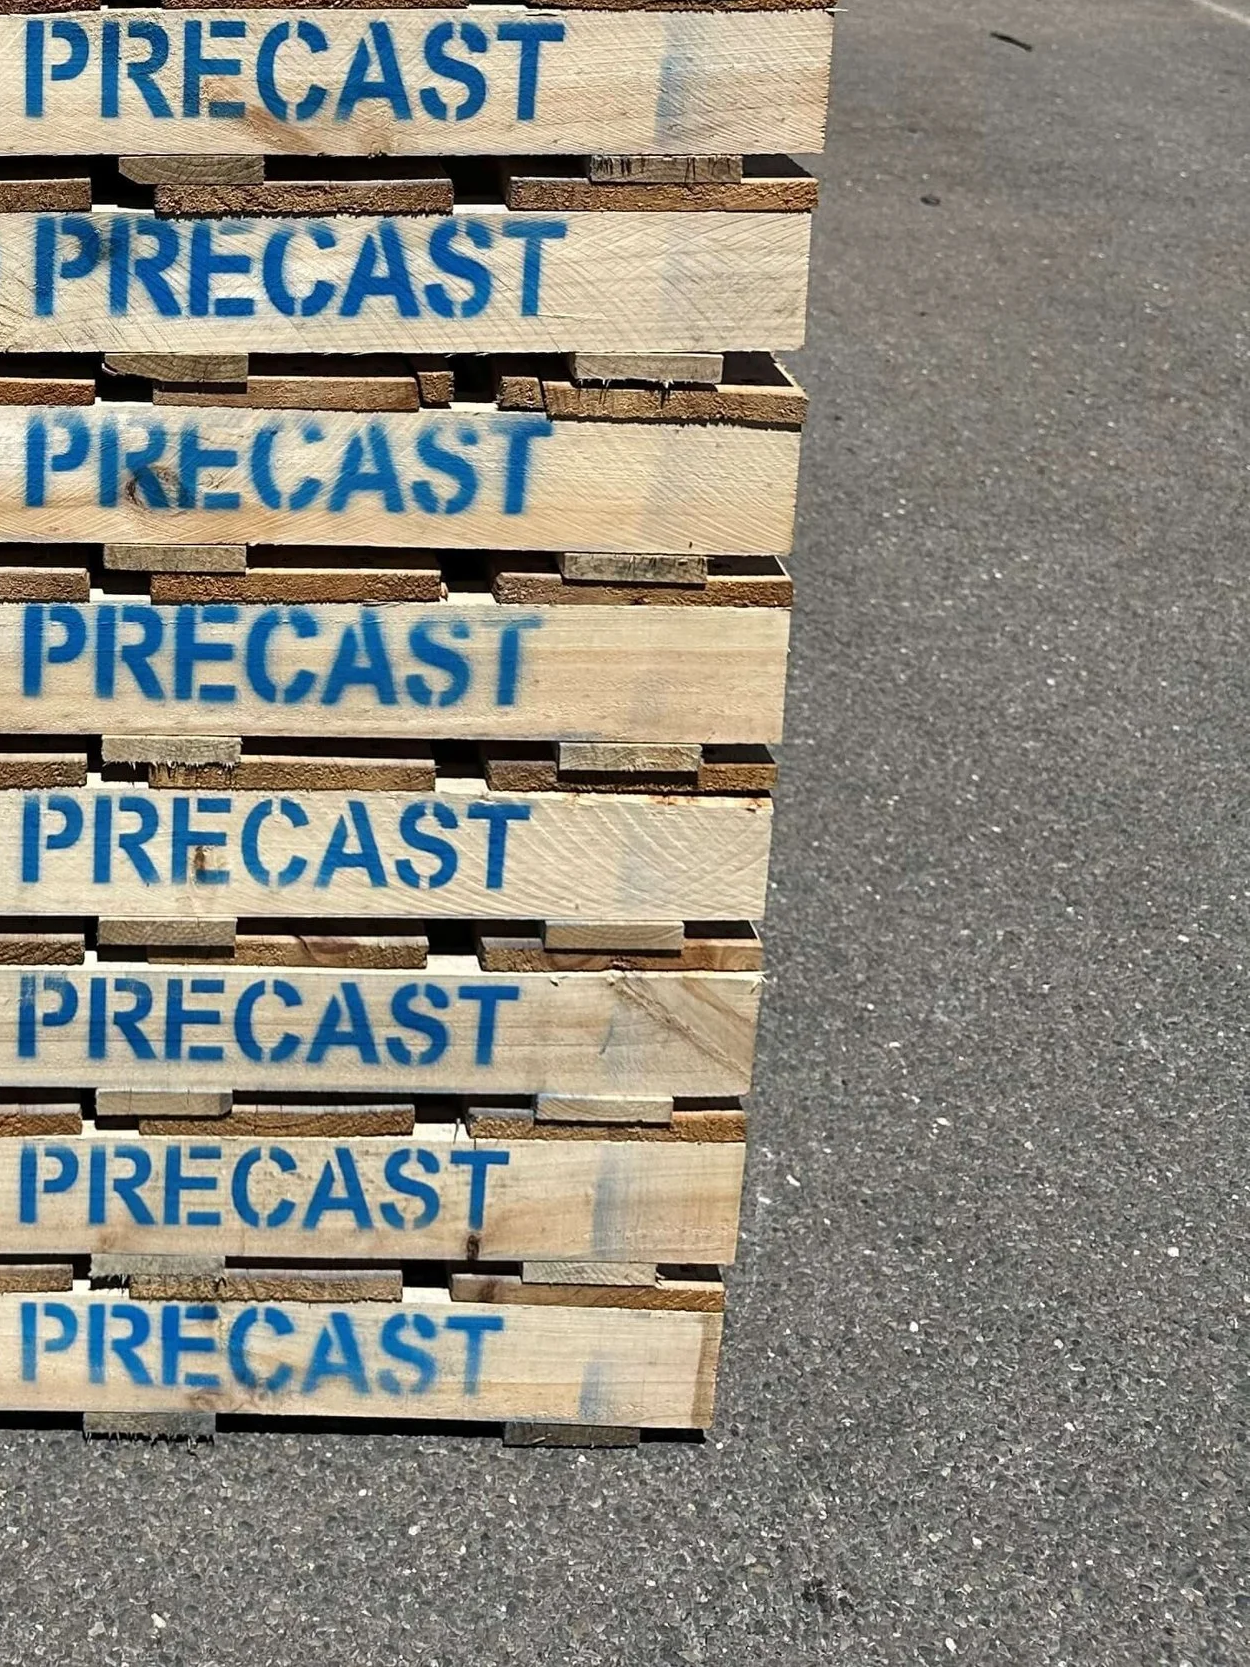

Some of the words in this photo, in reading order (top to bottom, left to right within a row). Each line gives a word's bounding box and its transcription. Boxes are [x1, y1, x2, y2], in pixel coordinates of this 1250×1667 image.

[25, 19, 565, 120] PRECAST
[34, 215, 565, 318] PRECAST
[25, 415, 551, 514] PRECAST
[22, 603, 538, 706] PRECAST
[21, 795, 531, 889] PRECAST
[17, 976, 521, 1066] PRECAST
[19, 1145, 510, 1229] PRECAST
[20, 1302, 504, 1394] PRECAST
